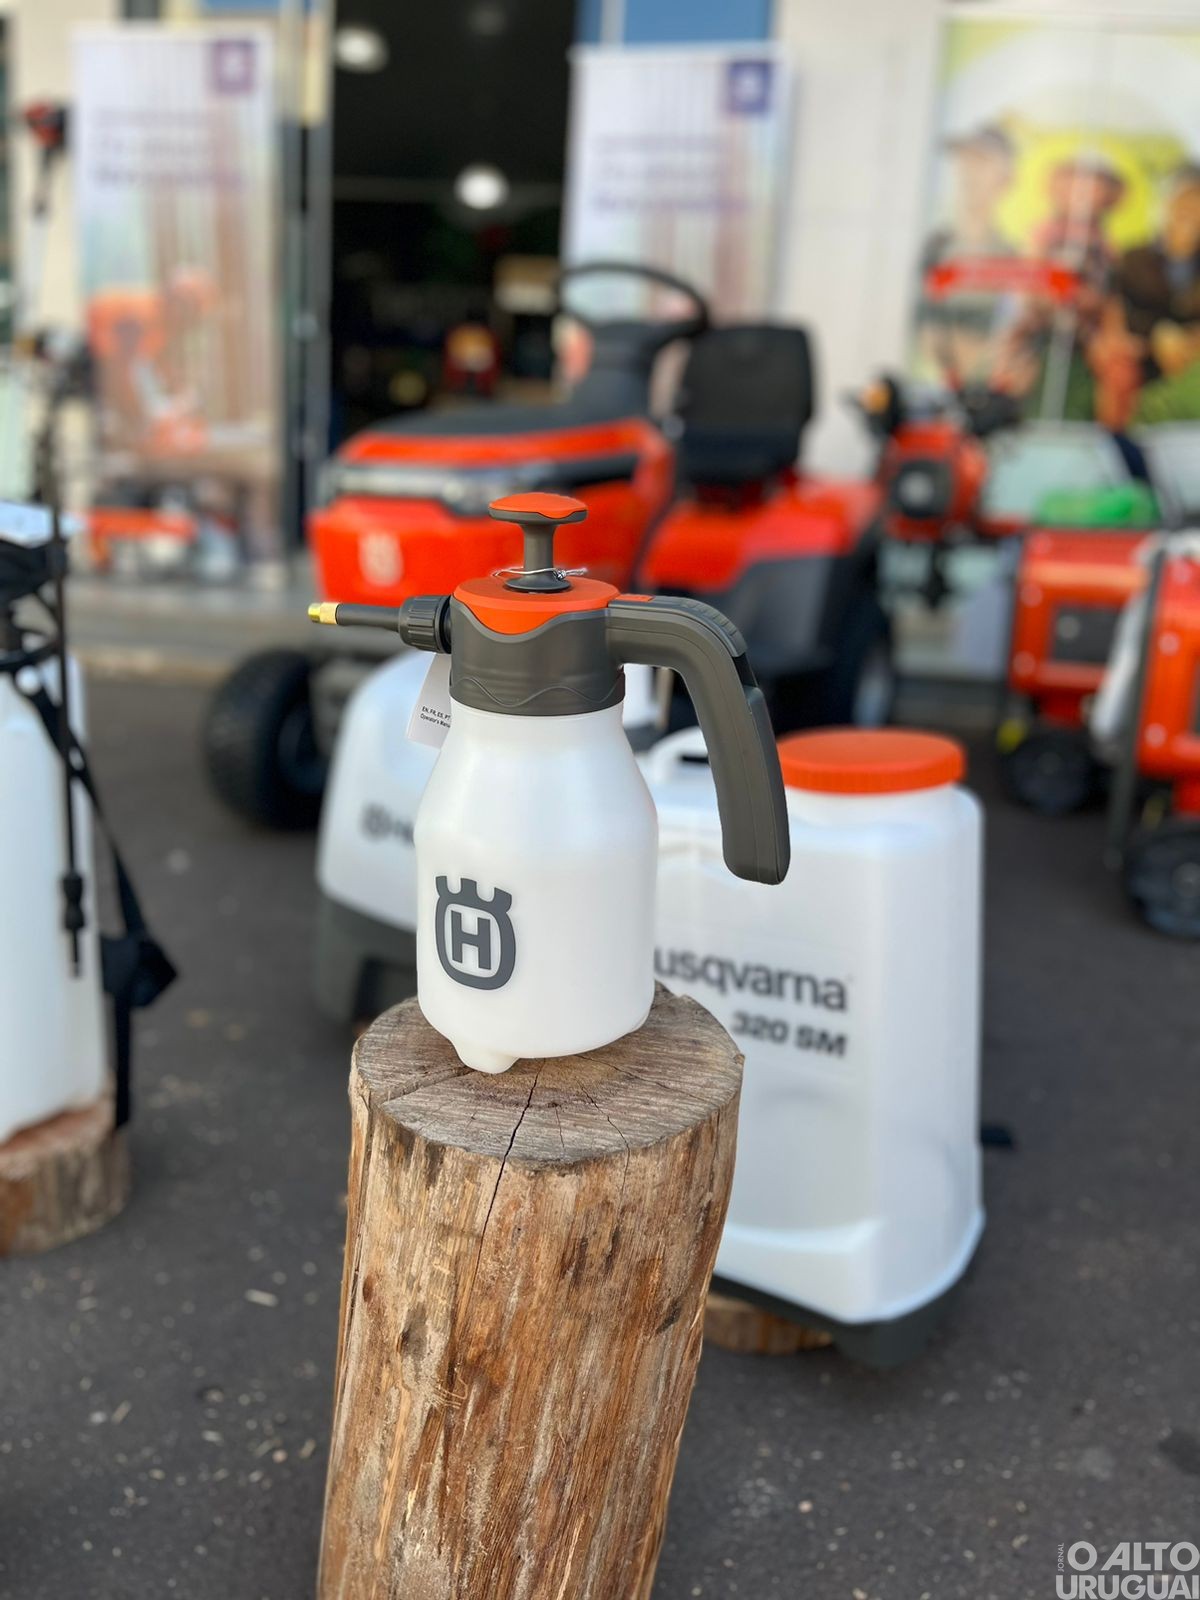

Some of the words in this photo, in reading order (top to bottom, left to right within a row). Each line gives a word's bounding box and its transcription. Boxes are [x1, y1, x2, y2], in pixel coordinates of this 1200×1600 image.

[420, 713, 440, 725] Operator's
[440, 720, 451, 728] Manu
[451, 910, 492, 970] H
[653, 947, 846, 1013] usqvarna
[733, 1011, 788, 1043] 320
[796, 1025, 846, 1056] SM
